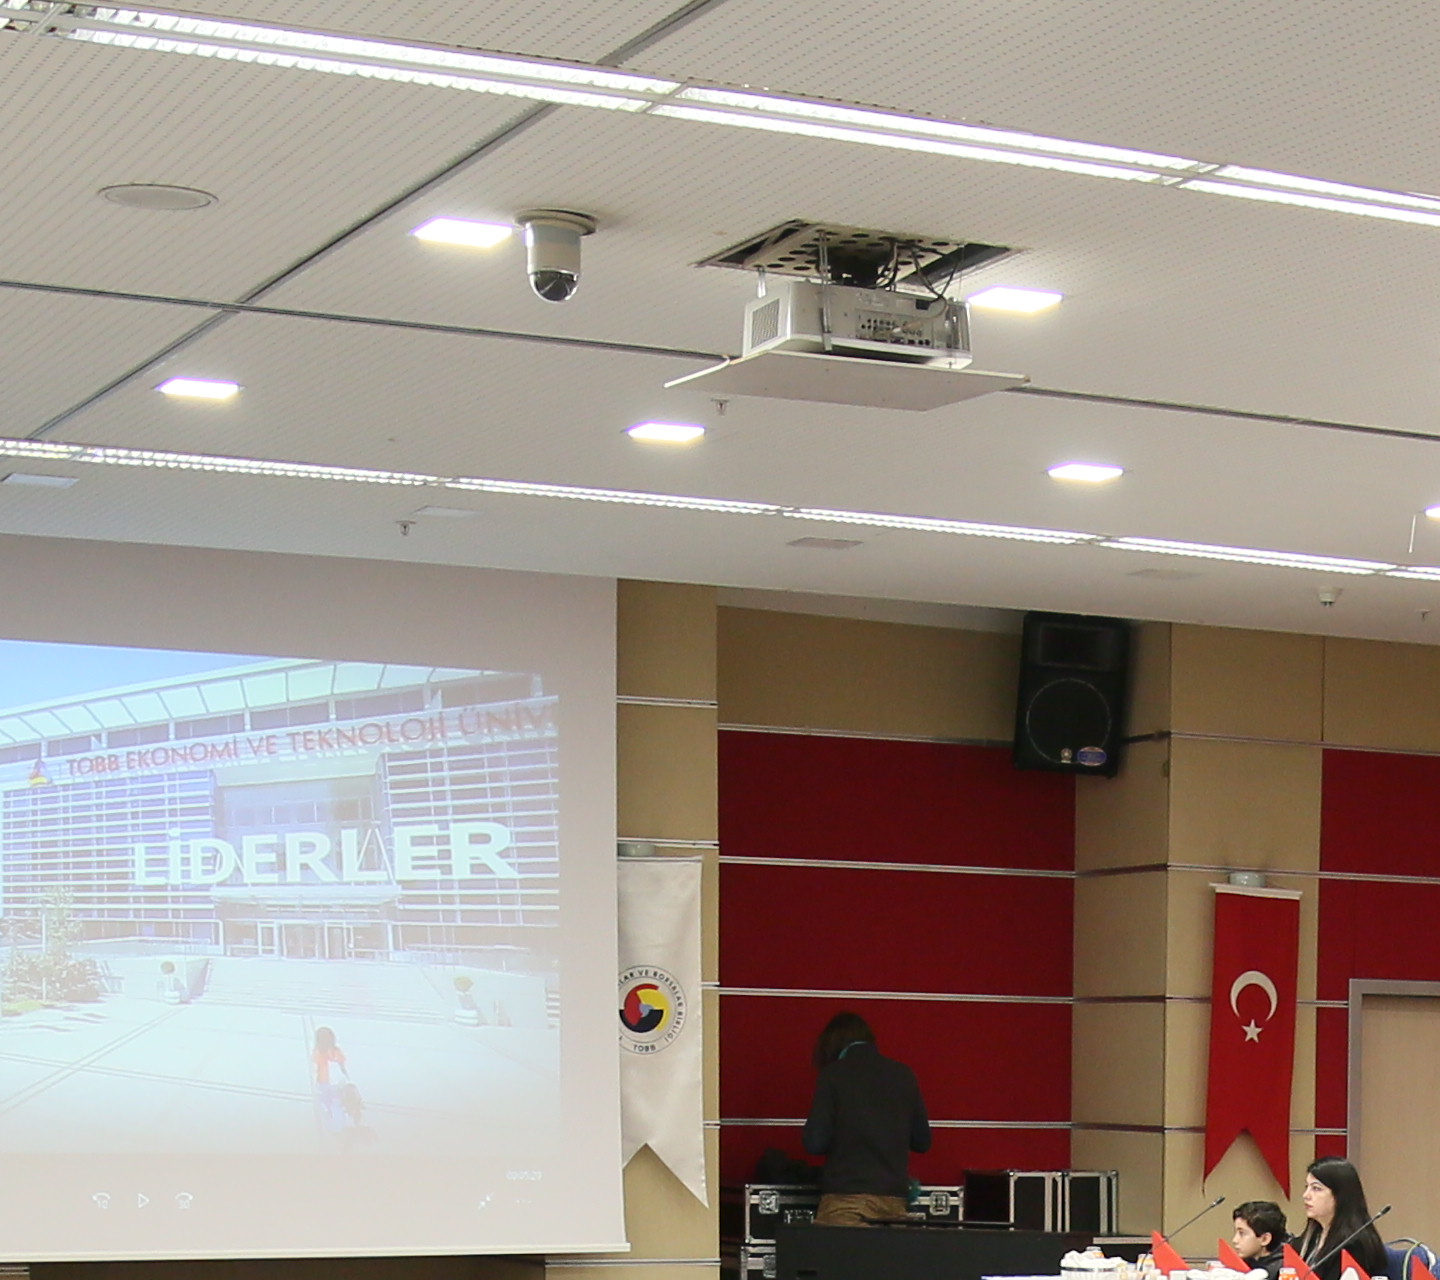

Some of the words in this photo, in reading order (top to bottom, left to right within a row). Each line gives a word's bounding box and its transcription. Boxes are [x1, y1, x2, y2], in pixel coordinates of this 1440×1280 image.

[66, 755, 119, 776] TOBB
[126, 736, 239, 769] EKONOMİ
[247, 735, 277, 758] VE
[286, 716, 447, 753] TEKNOLOJİ
[132, 820, 519, 887] LİDERLER
[633, 1043, 657, 1053] TOBB
